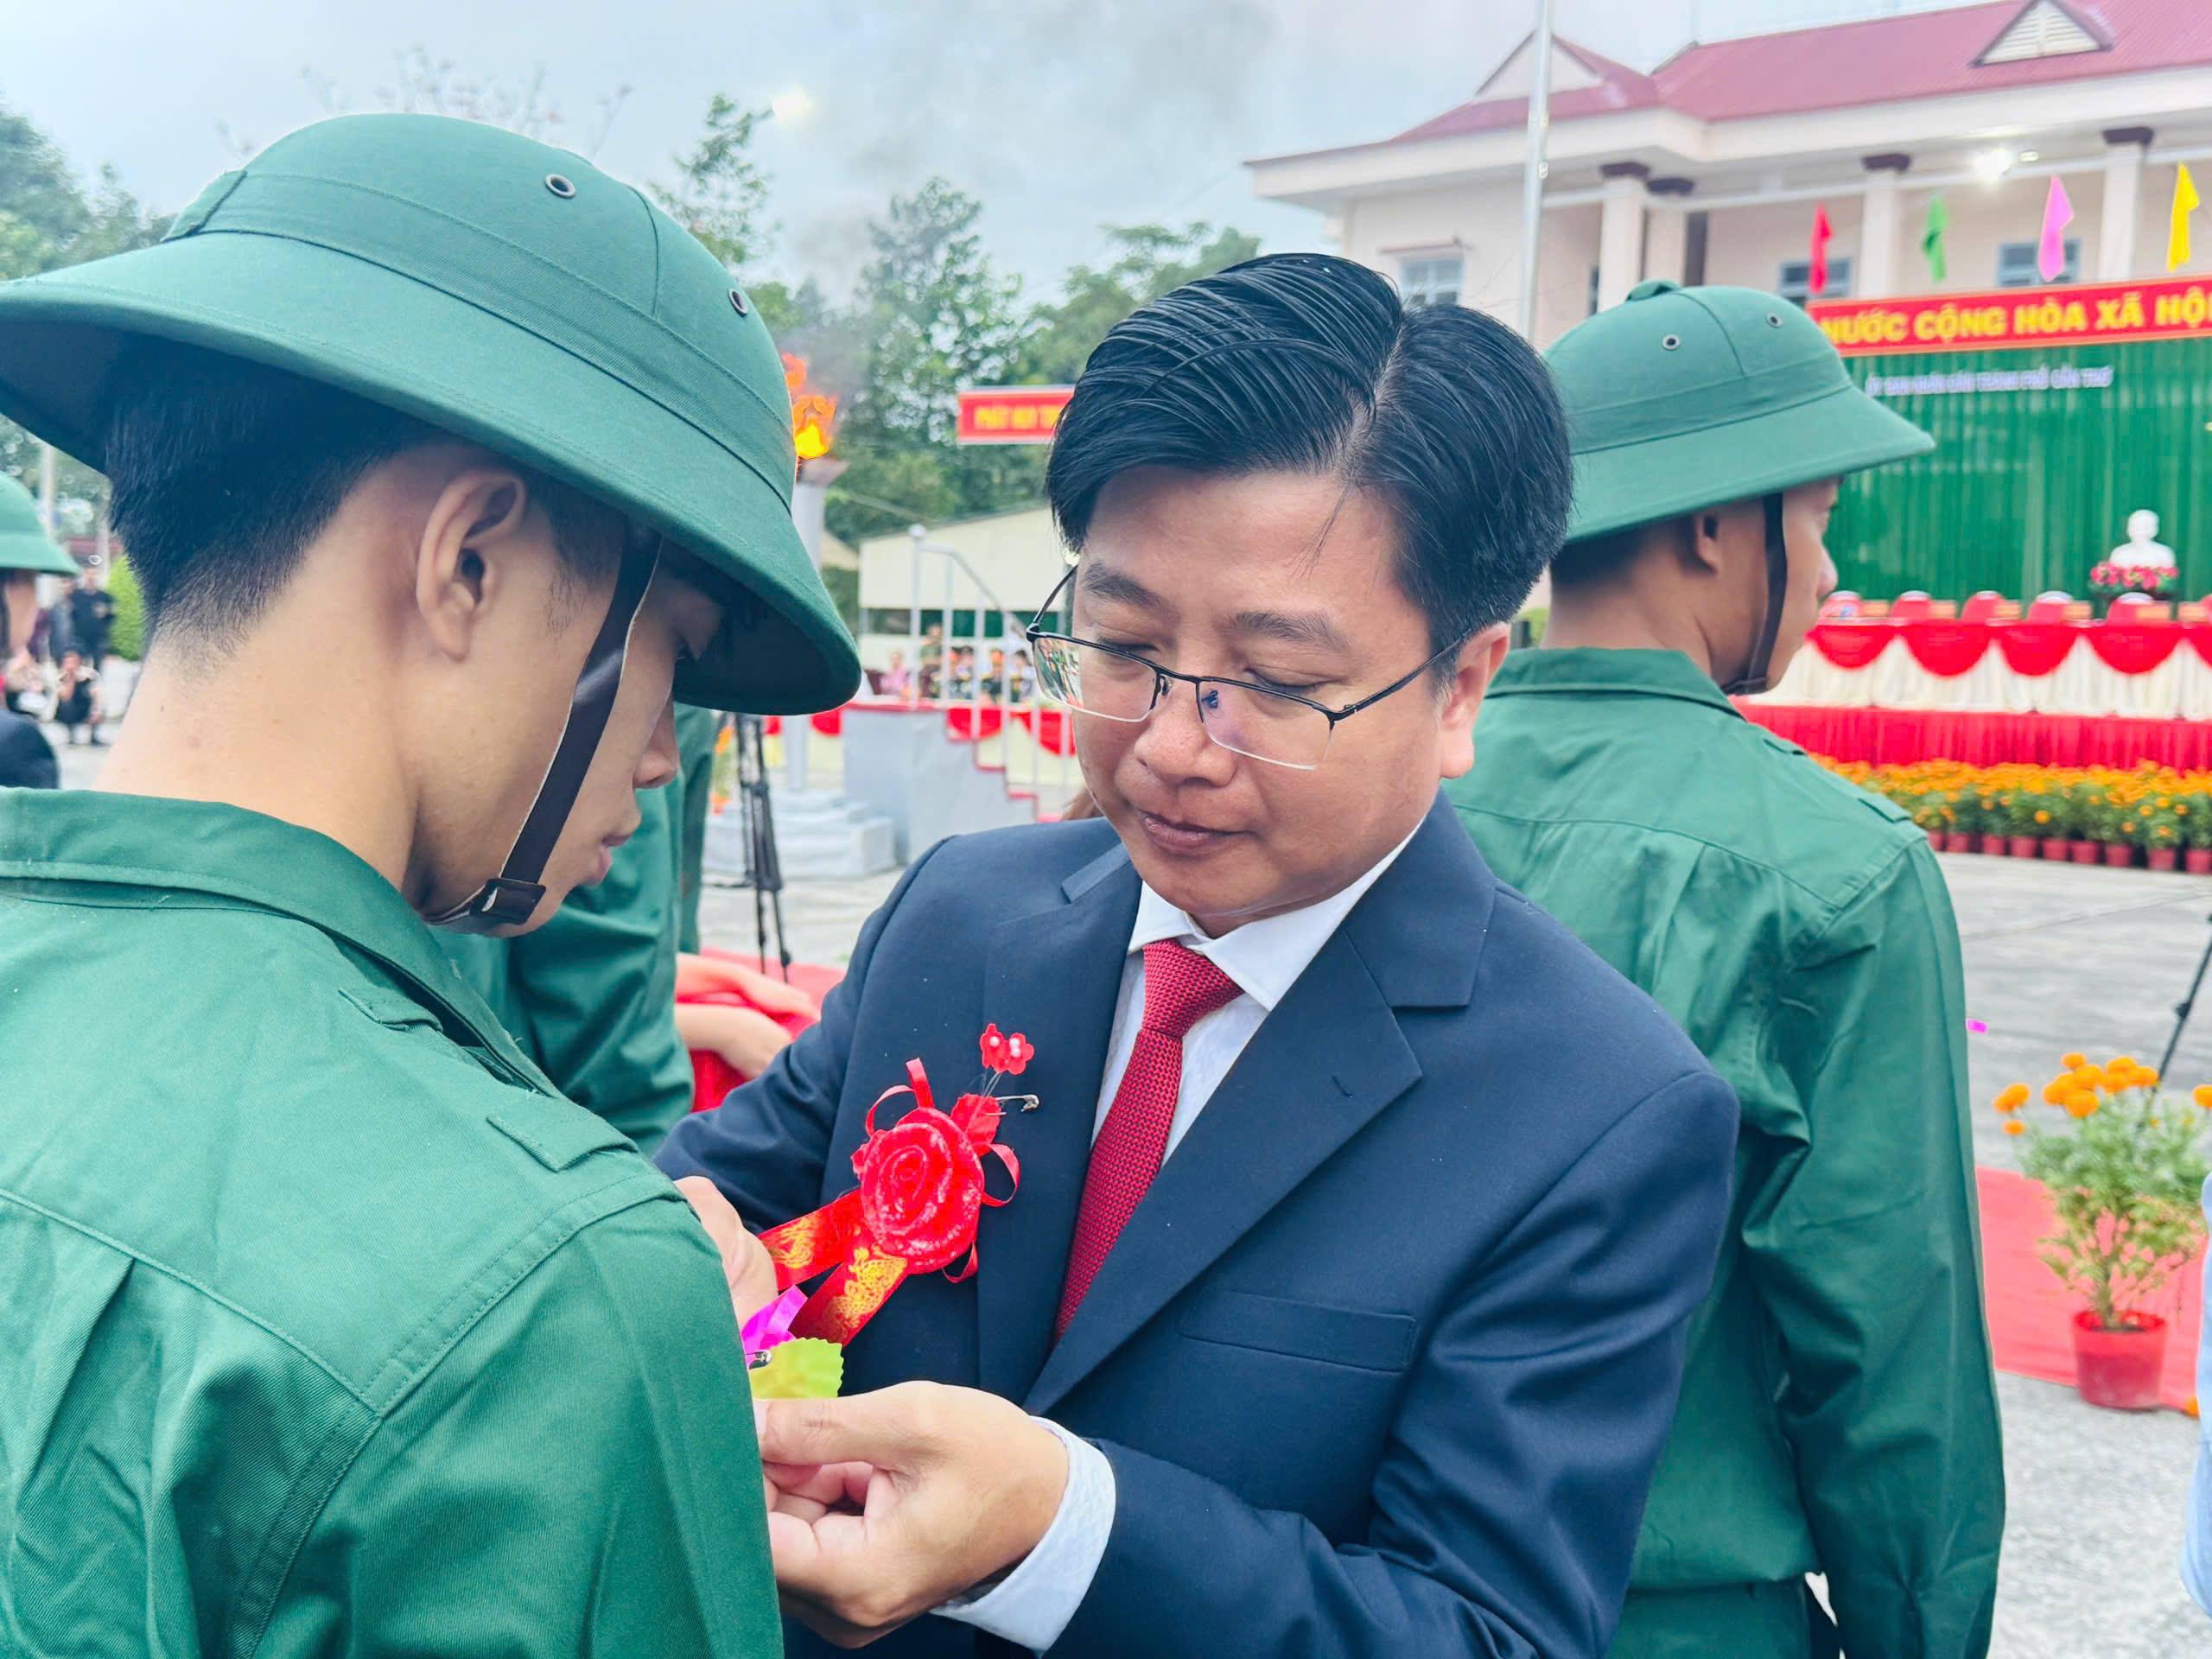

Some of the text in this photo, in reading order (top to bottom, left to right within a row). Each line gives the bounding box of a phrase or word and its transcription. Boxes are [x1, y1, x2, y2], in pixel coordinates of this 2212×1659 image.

[1820, 308, 1908, 344] NƯỚC
[1914, 302, 2006, 342] CỘNG
[2013, 296, 2087, 334] HÒA
[2095, 291, 2144, 330] XÃ
